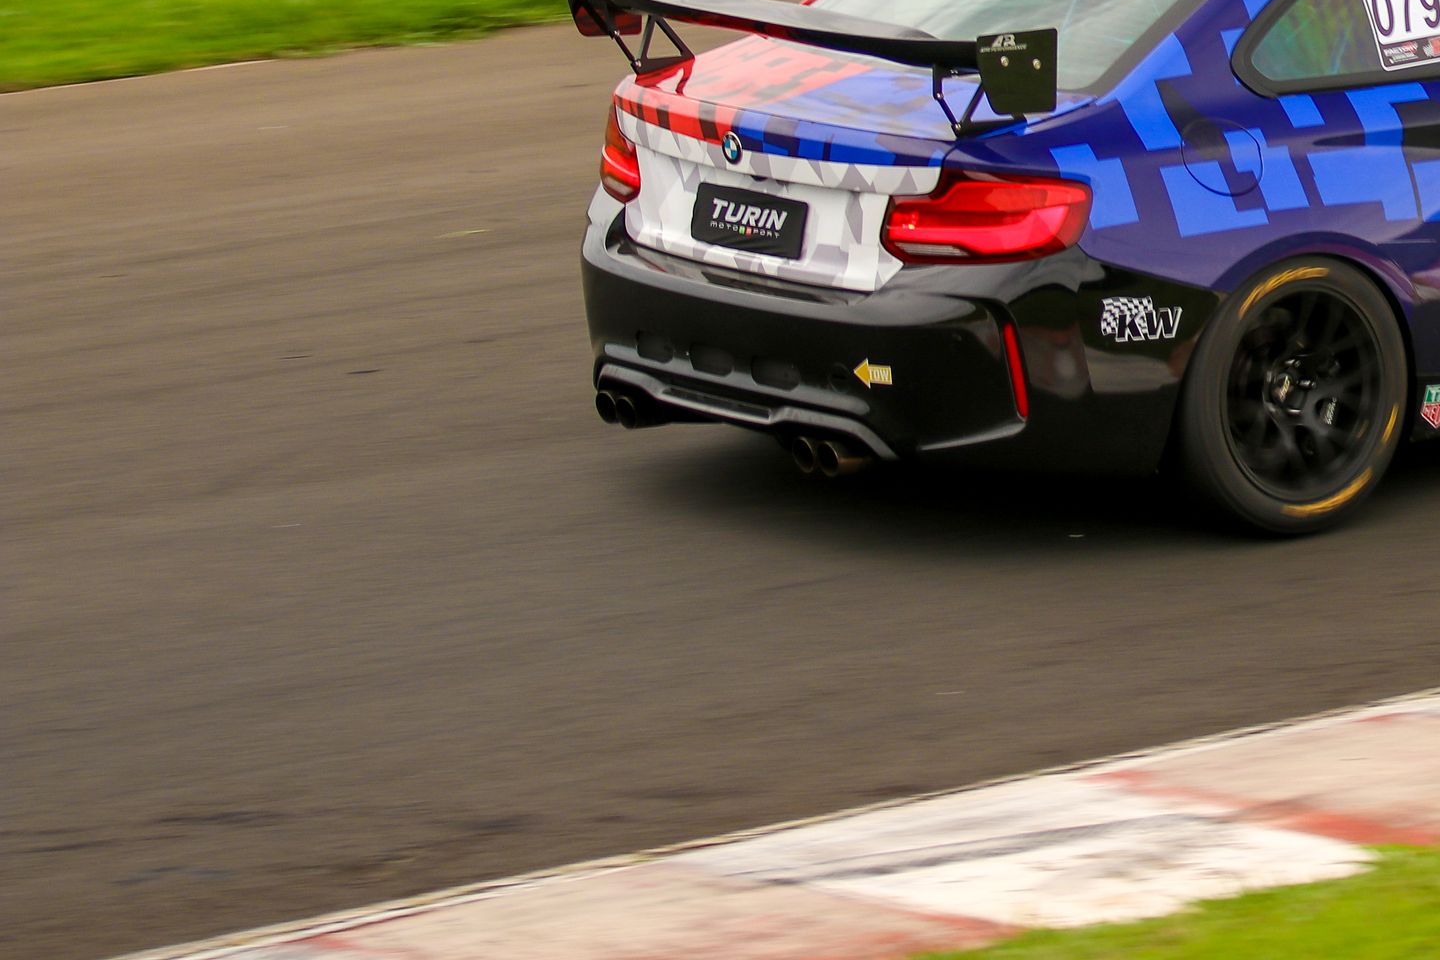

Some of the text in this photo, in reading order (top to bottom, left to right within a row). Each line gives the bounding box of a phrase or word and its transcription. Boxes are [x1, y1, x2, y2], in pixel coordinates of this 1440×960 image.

[712, 197, 788, 231] TURIN
[1115, 306, 1183, 342] KW
[868, 367, 890, 382] TOW
